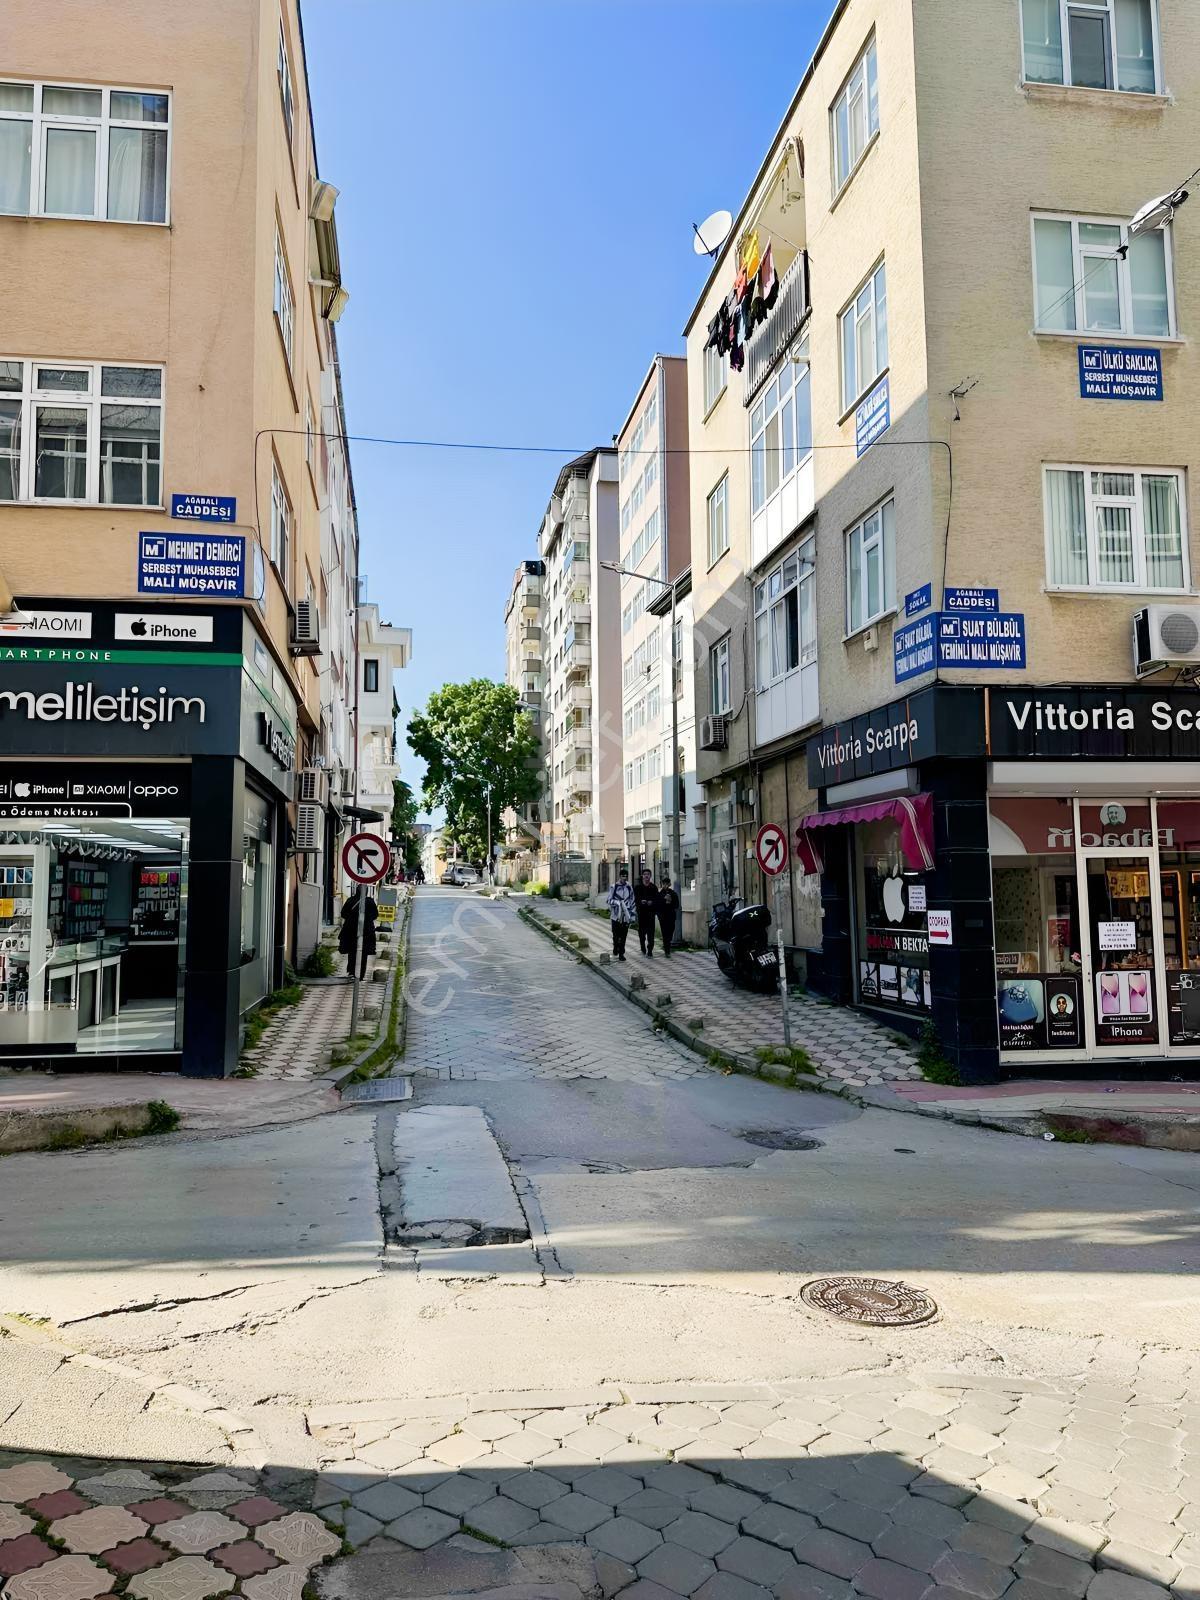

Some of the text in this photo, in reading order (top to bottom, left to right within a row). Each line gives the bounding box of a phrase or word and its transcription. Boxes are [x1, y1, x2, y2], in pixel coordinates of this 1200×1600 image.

[1103, 350, 1124, 369] ÜLKÜ
[1126, 354, 1158, 371] SAKLICA
[1084, 372, 1158, 384] SERBEST MUHASEBECİ
[1086, 383, 1157, 396] MALİ MÜŞAVİR
[176, 504, 231, 517] CADDESİ
[168, 541, 204, 560] MEHMET
[206, 539, 241, 561] DEMİRCİ
[143, 563, 239, 577] SERBEST MUHASEBECİ
[144, 576, 236, 591] MALİ MÜŞAVİR
[151, 624, 197, 637] iPhone
[962, 620, 984, 637] SUAT
[987, 618, 1021, 638] BÜLBÜL
[0, 649, 111, 660] ARTPHONE
[940, 640, 1021, 665] YEMİNLİ MALİ MÜŞAVİR
[1006, 701, 1135, 731] Vittoria
[818, 720, 918, 769] Vittoria Scarpa
[33, 784, 64, 795] iPhone
[86, 785, 126, 795] XIAOMI
[134, 785, 179, 797] oppo
[11, 805, 50, 816] Ödeme
[54, 807, 99, 816] Noktası
[902, 936, 931, 953] BEKTA
[1111, 1025, 1143, 1036] iPhone
